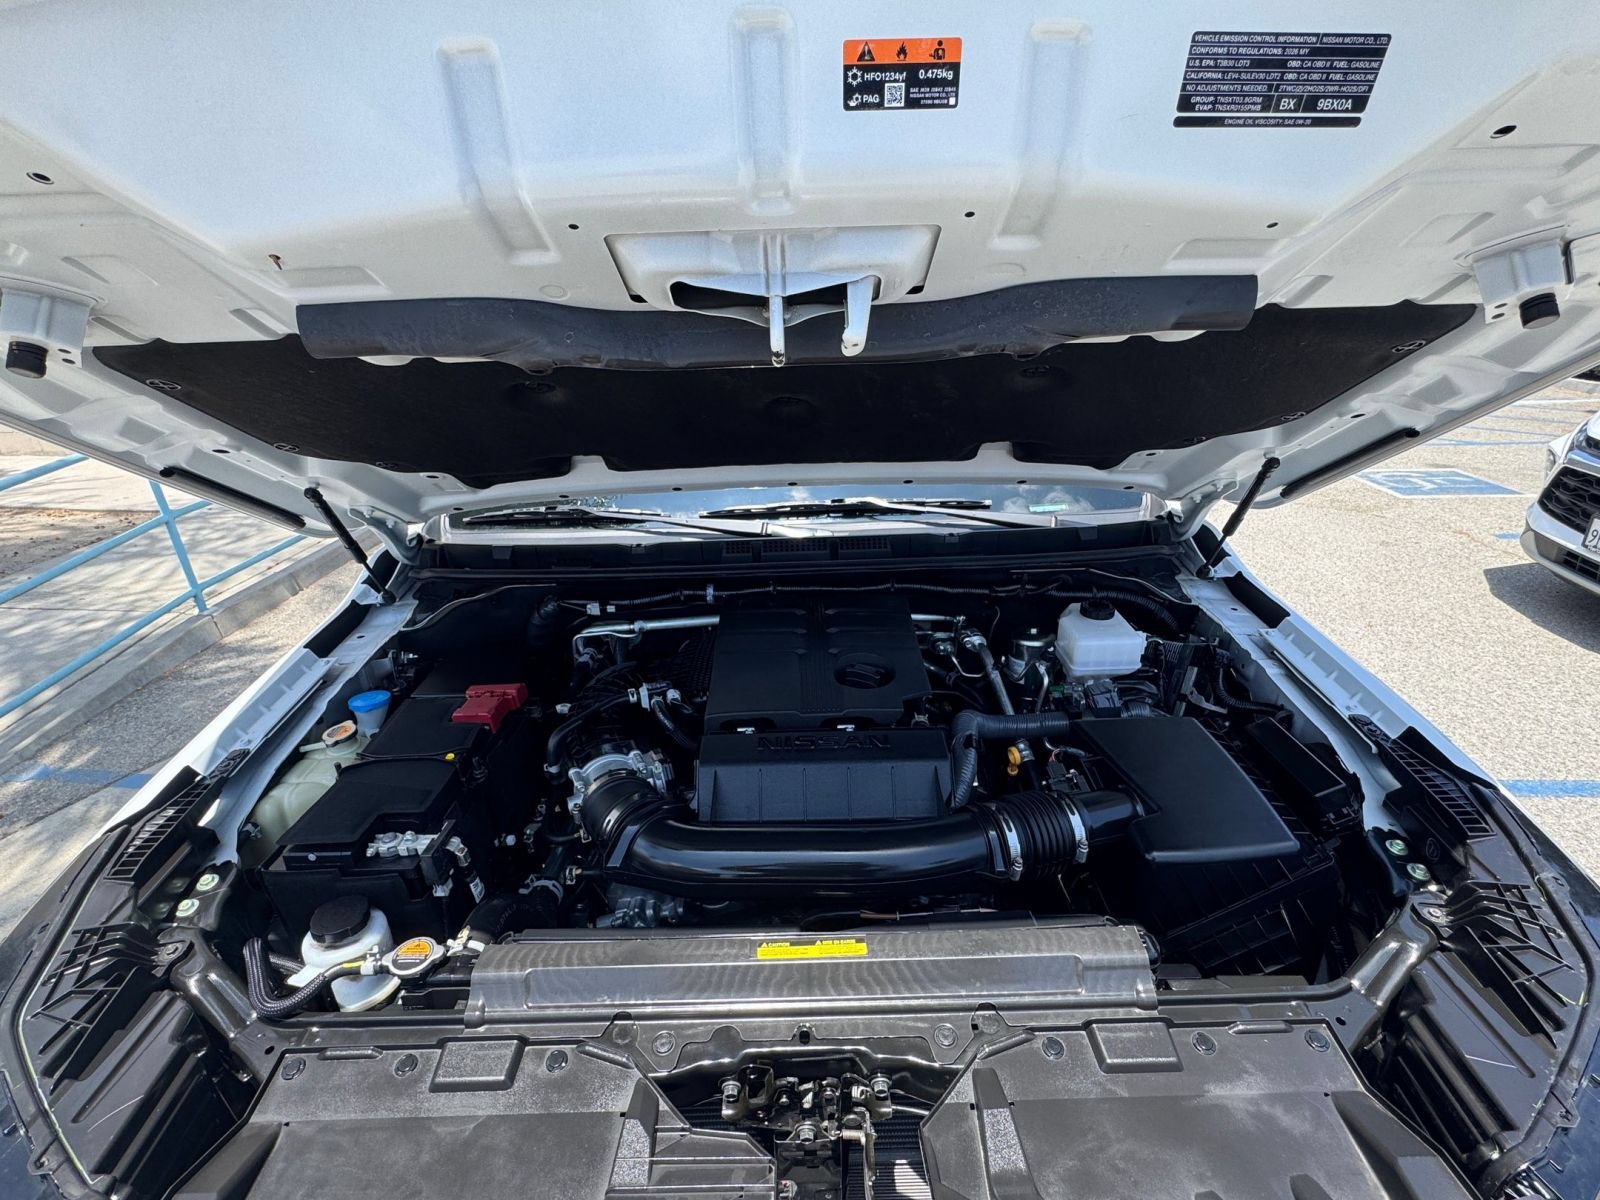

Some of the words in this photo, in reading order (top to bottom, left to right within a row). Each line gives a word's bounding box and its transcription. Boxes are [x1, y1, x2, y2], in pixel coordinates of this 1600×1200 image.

[864, 72, 906, 82] HFO1234yf
[919, 69, 953, 80] 0.475kg
[863, 94, 879, 103] PAG
[1279, 98, 1297, 110] BX
[1316, 98, 1352, 110] 9BX0A
[757, 735, 891, 750] NISSAN
